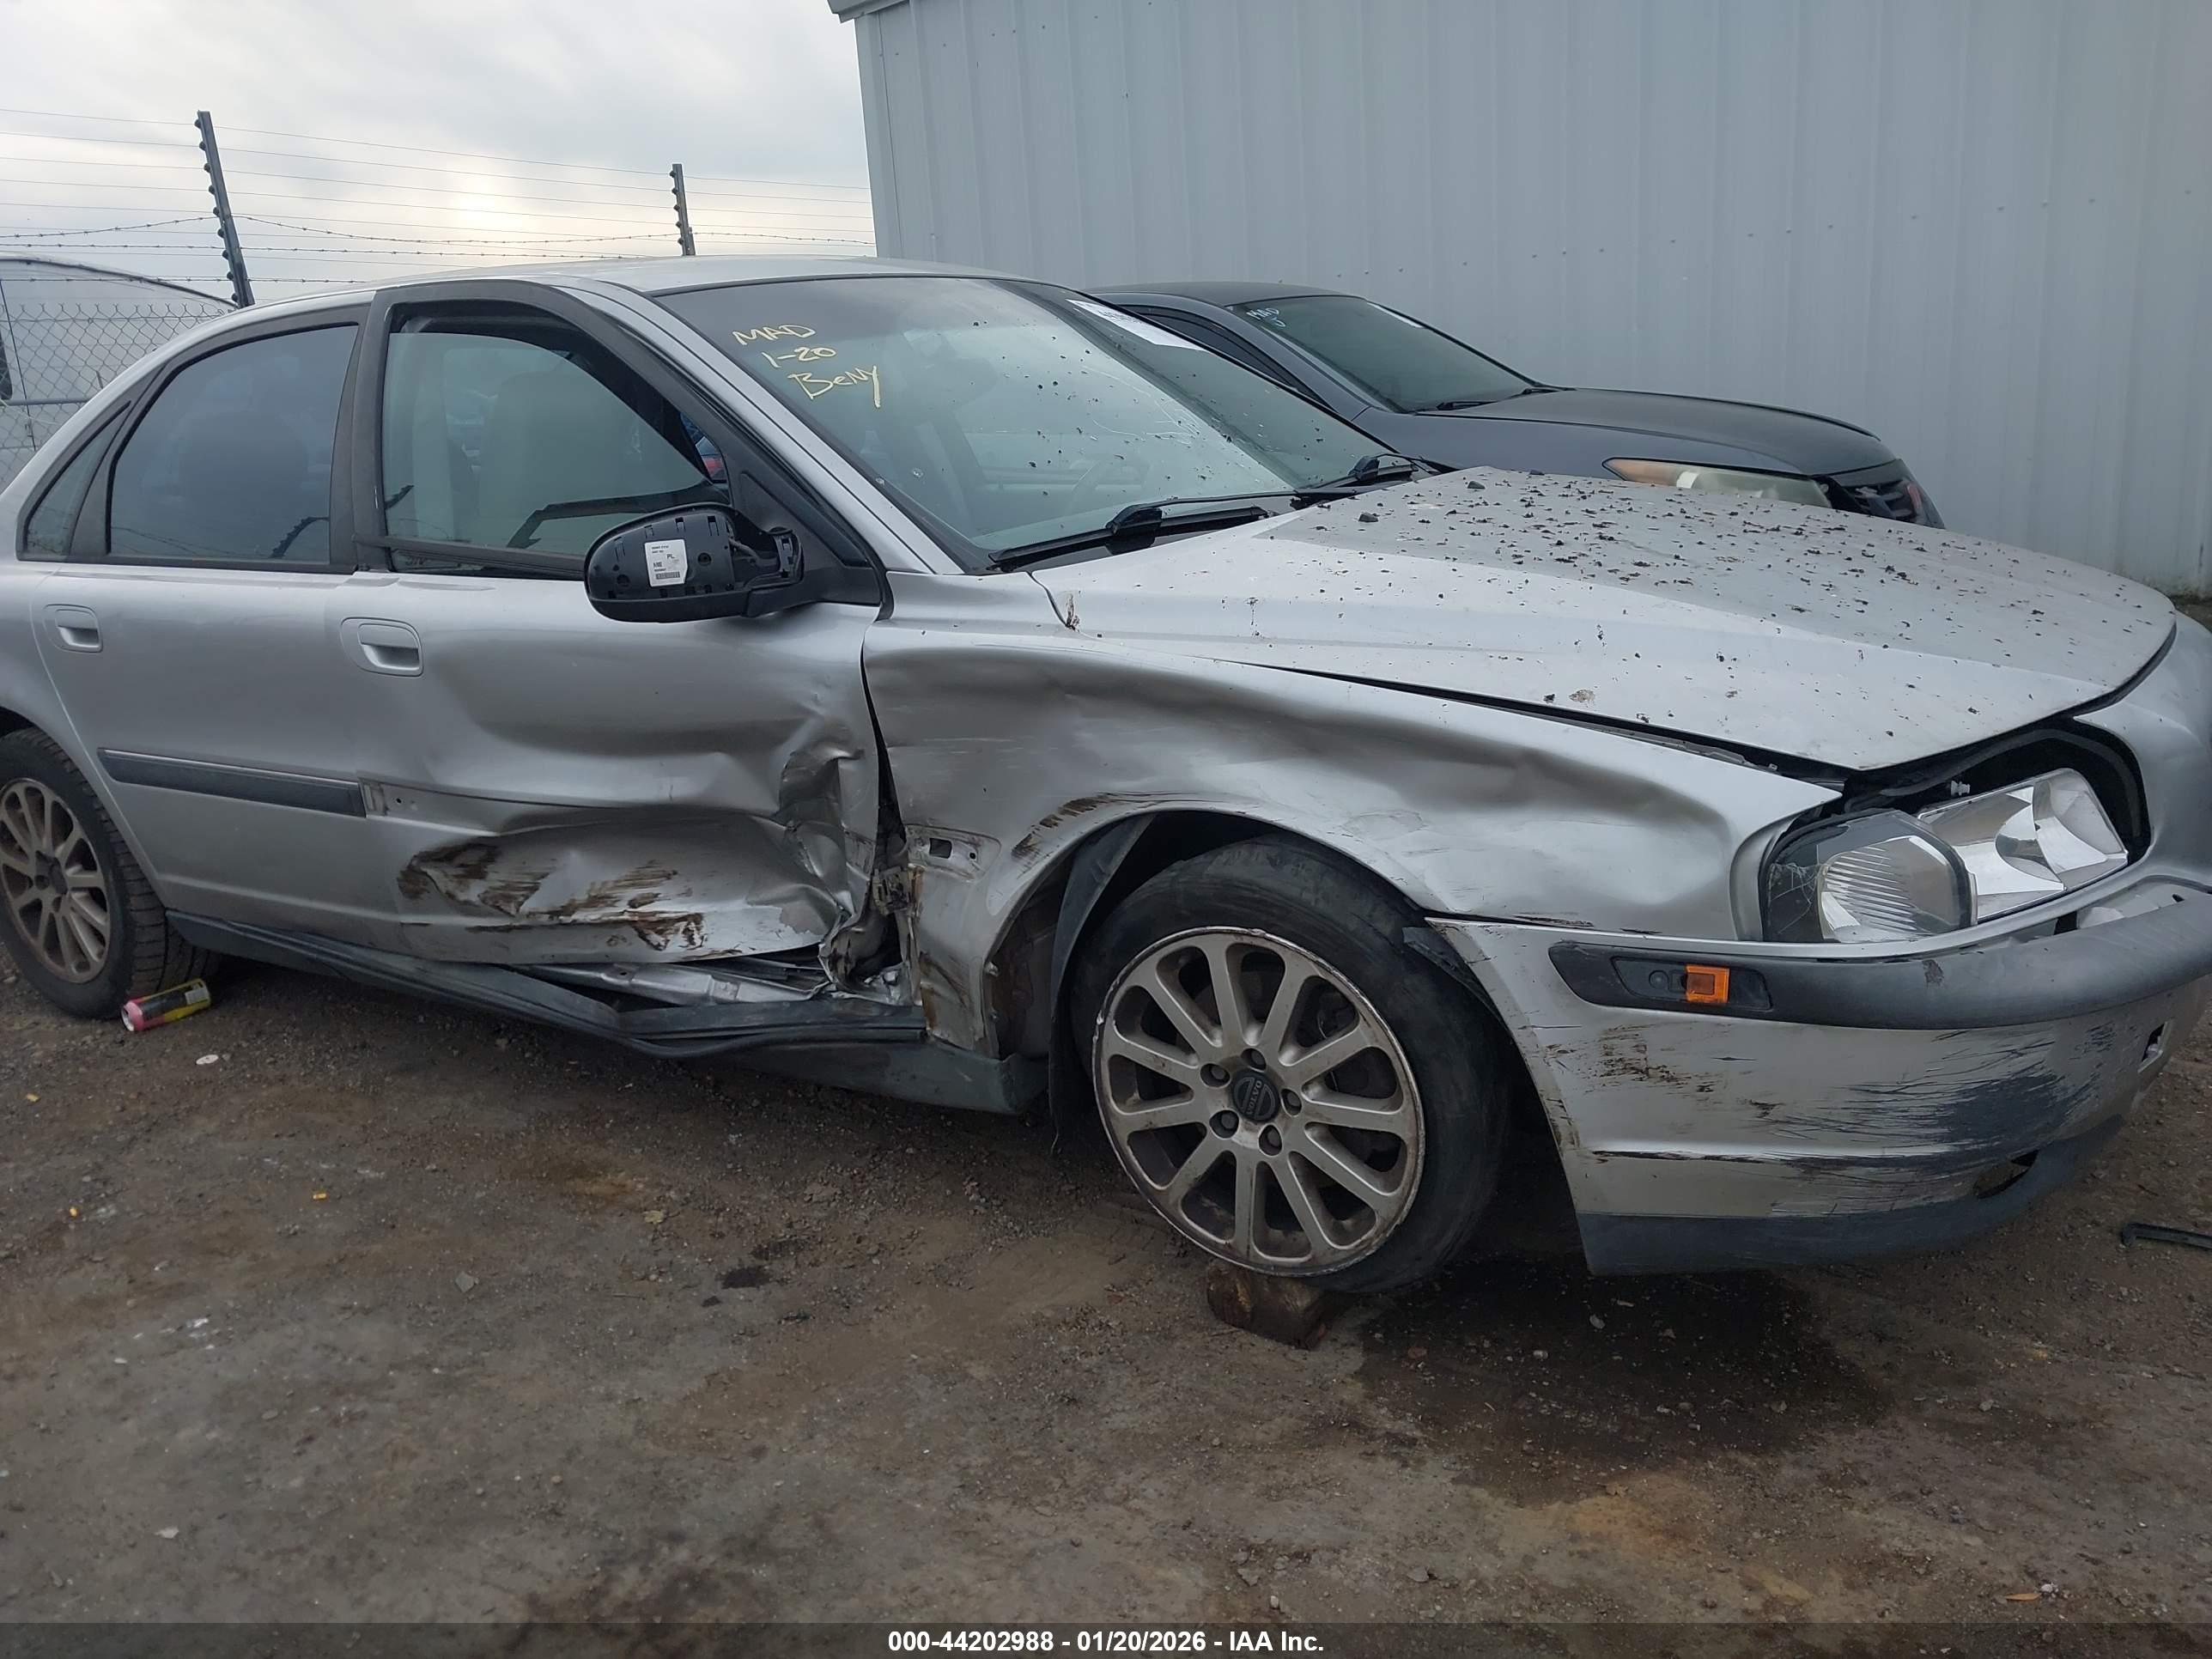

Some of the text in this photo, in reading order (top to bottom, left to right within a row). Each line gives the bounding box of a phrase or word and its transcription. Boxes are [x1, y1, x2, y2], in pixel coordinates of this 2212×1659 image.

[732, 325, 816, 345] MAD
[762, 346, 837, 368] 1-20
[1246, 1080, 1262, 1115] VOLVO
